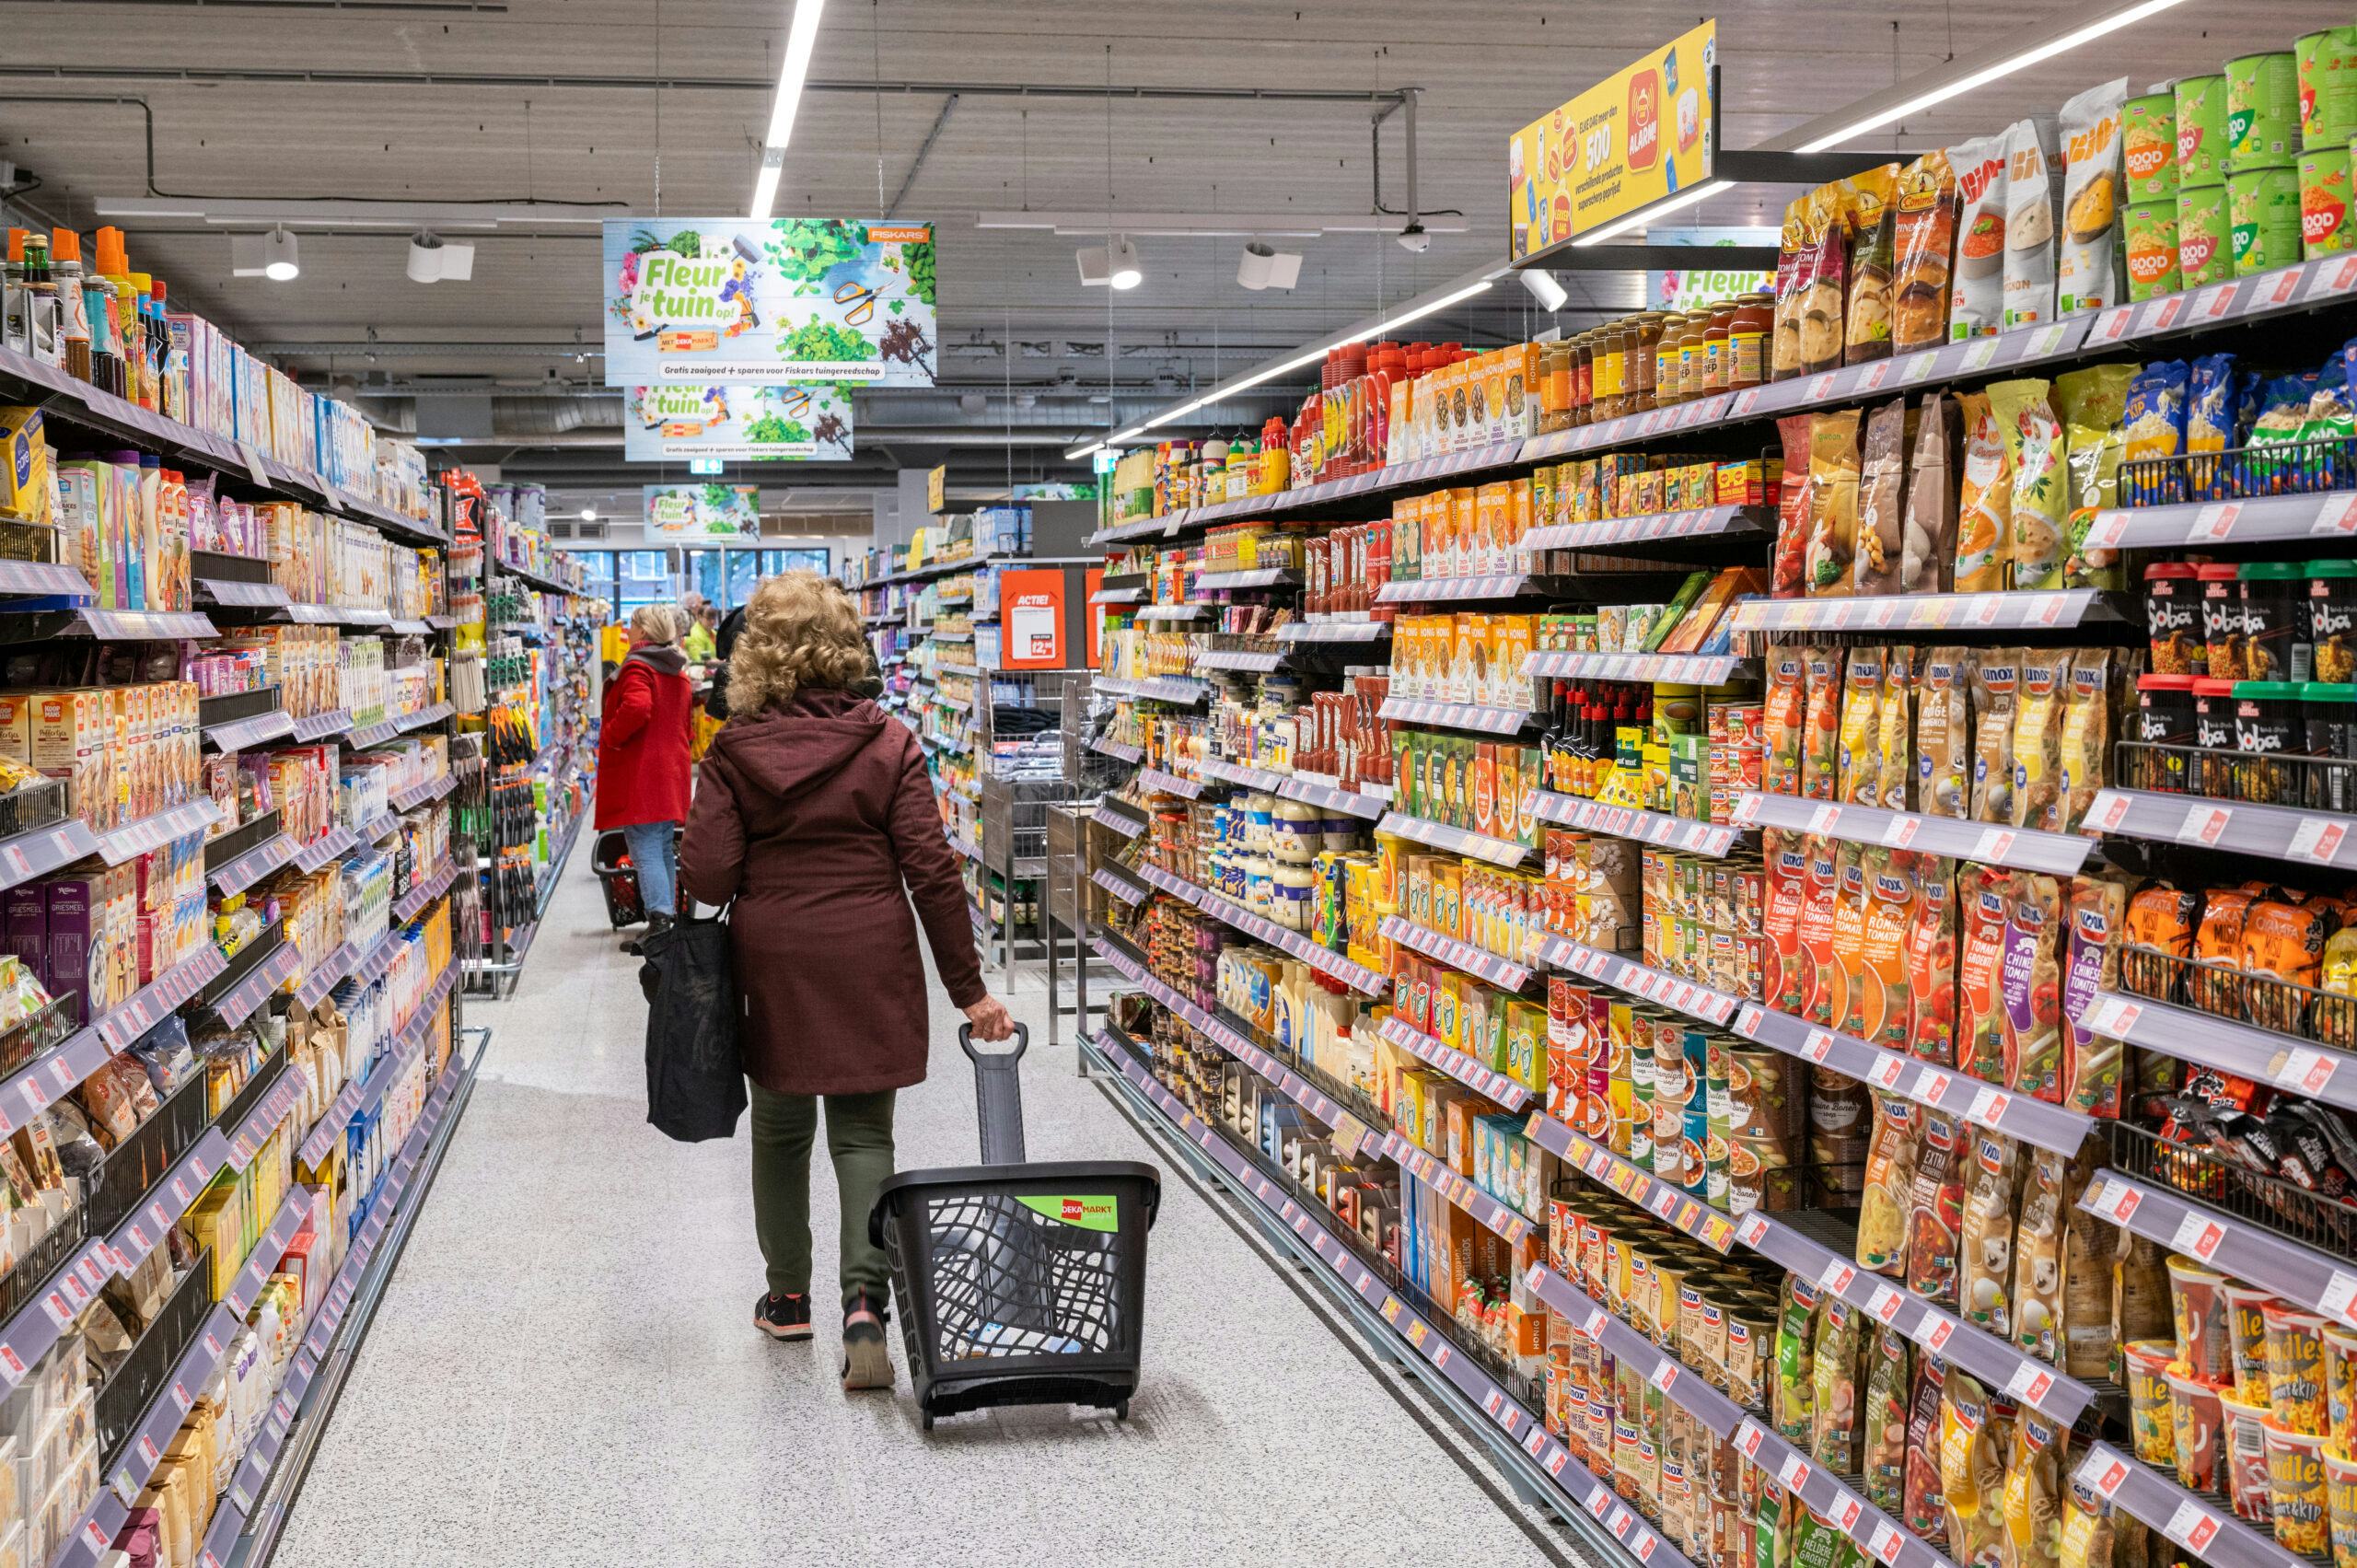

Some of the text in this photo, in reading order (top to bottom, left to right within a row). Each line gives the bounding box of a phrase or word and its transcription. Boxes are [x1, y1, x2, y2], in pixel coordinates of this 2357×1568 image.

[1598, 111, 1608, 123] meer
[1608, 106, 1618, 118] dan
[1629, 121, 1656, 157] ALARM!
[1586, 123, 1610, 172] 500
[2128, 151, 2163, 167] GOOD
[2133, 164, 2154, 172] PASTA
[1575, 164, 1623, 195] verschillende producten
[1578, 181, 1621, 211] superscherp geprijsd!
[2303, 212, 2334, 227] GOOD
[872, 230, 925, 239] FISKARS
[2305, 226, 2324, 236] PASTA
[2180, 246, 2208, 260] GOOD
[2131, 256, 2167, 269] GOOD
[646, 259, 726, 287] Fleur
[1685, 271, 1760, 293] Fleur
[640, 287, 735, 319] je tuin op!
[1680, 297, 1689, 308] je
[1486, 363, 1504, 376] HONIG
[1506, 357, 1522, 370] HONIG
[691, 366, 726, 376] zaaigoed
[737, 367, 764, 377] sparen
[815, 367, 880, 377] tuingereedschap
[1469, 369, 1484, 381] HONIG
[1434, 378, 1449, 389] HONIG
[1451, 374, 1467, 385] HONIG
[648, 396, 656, 404] je
[657, 393, 701, 413] tuin
[2128, 401, 2144, 419] KIP
[1492, 494, 1506, 505] HONIG
[661, 510, 682, 519] tuin
[1017, 595, 1049, 605] ACTIE!
[2148, 598, 2193, 636] Soba
[2201, 600, 2245, 639] Soba
[2243, 607, 2266, 634] ba
[1421, 627, 1434, 637] HONIG
[1496, 628, 1506, 638] HONI
[1509, 628, 1527, 639] HONIG
[1983, 668, 2014, 680] unox
[2142, 714, 2165, 740] oba
[2199, 720, 2227, 747] oba
[2235, 718, 2282, 752] Soba
[1868, 917, 1906, 932] ROMIGE
[2142, 911, 2158, 931] MISO
[2257, 915, 2298, 939] OYAKATA
[2214, 924, 2235, 944] MISO
[1972, 940, 1997, 954] TOMAAT
[2264, 935, 2282, 958] MISO
[1967, 953, 1993, 967] GROENTE
[2073, 963, 2101, 981] CHINESE
[1831, 1102, 1858, 1111] Bonen
[1923, 1150, 1945, 1170] EXTRA
[1704, 1307, 1718, 1319] nox
[1730, 1324, 1746, 1337] nox
[1804, 1539, 1833, 1559] HELDERE
[1799, 1550, 1829, 1568] GROENTE
